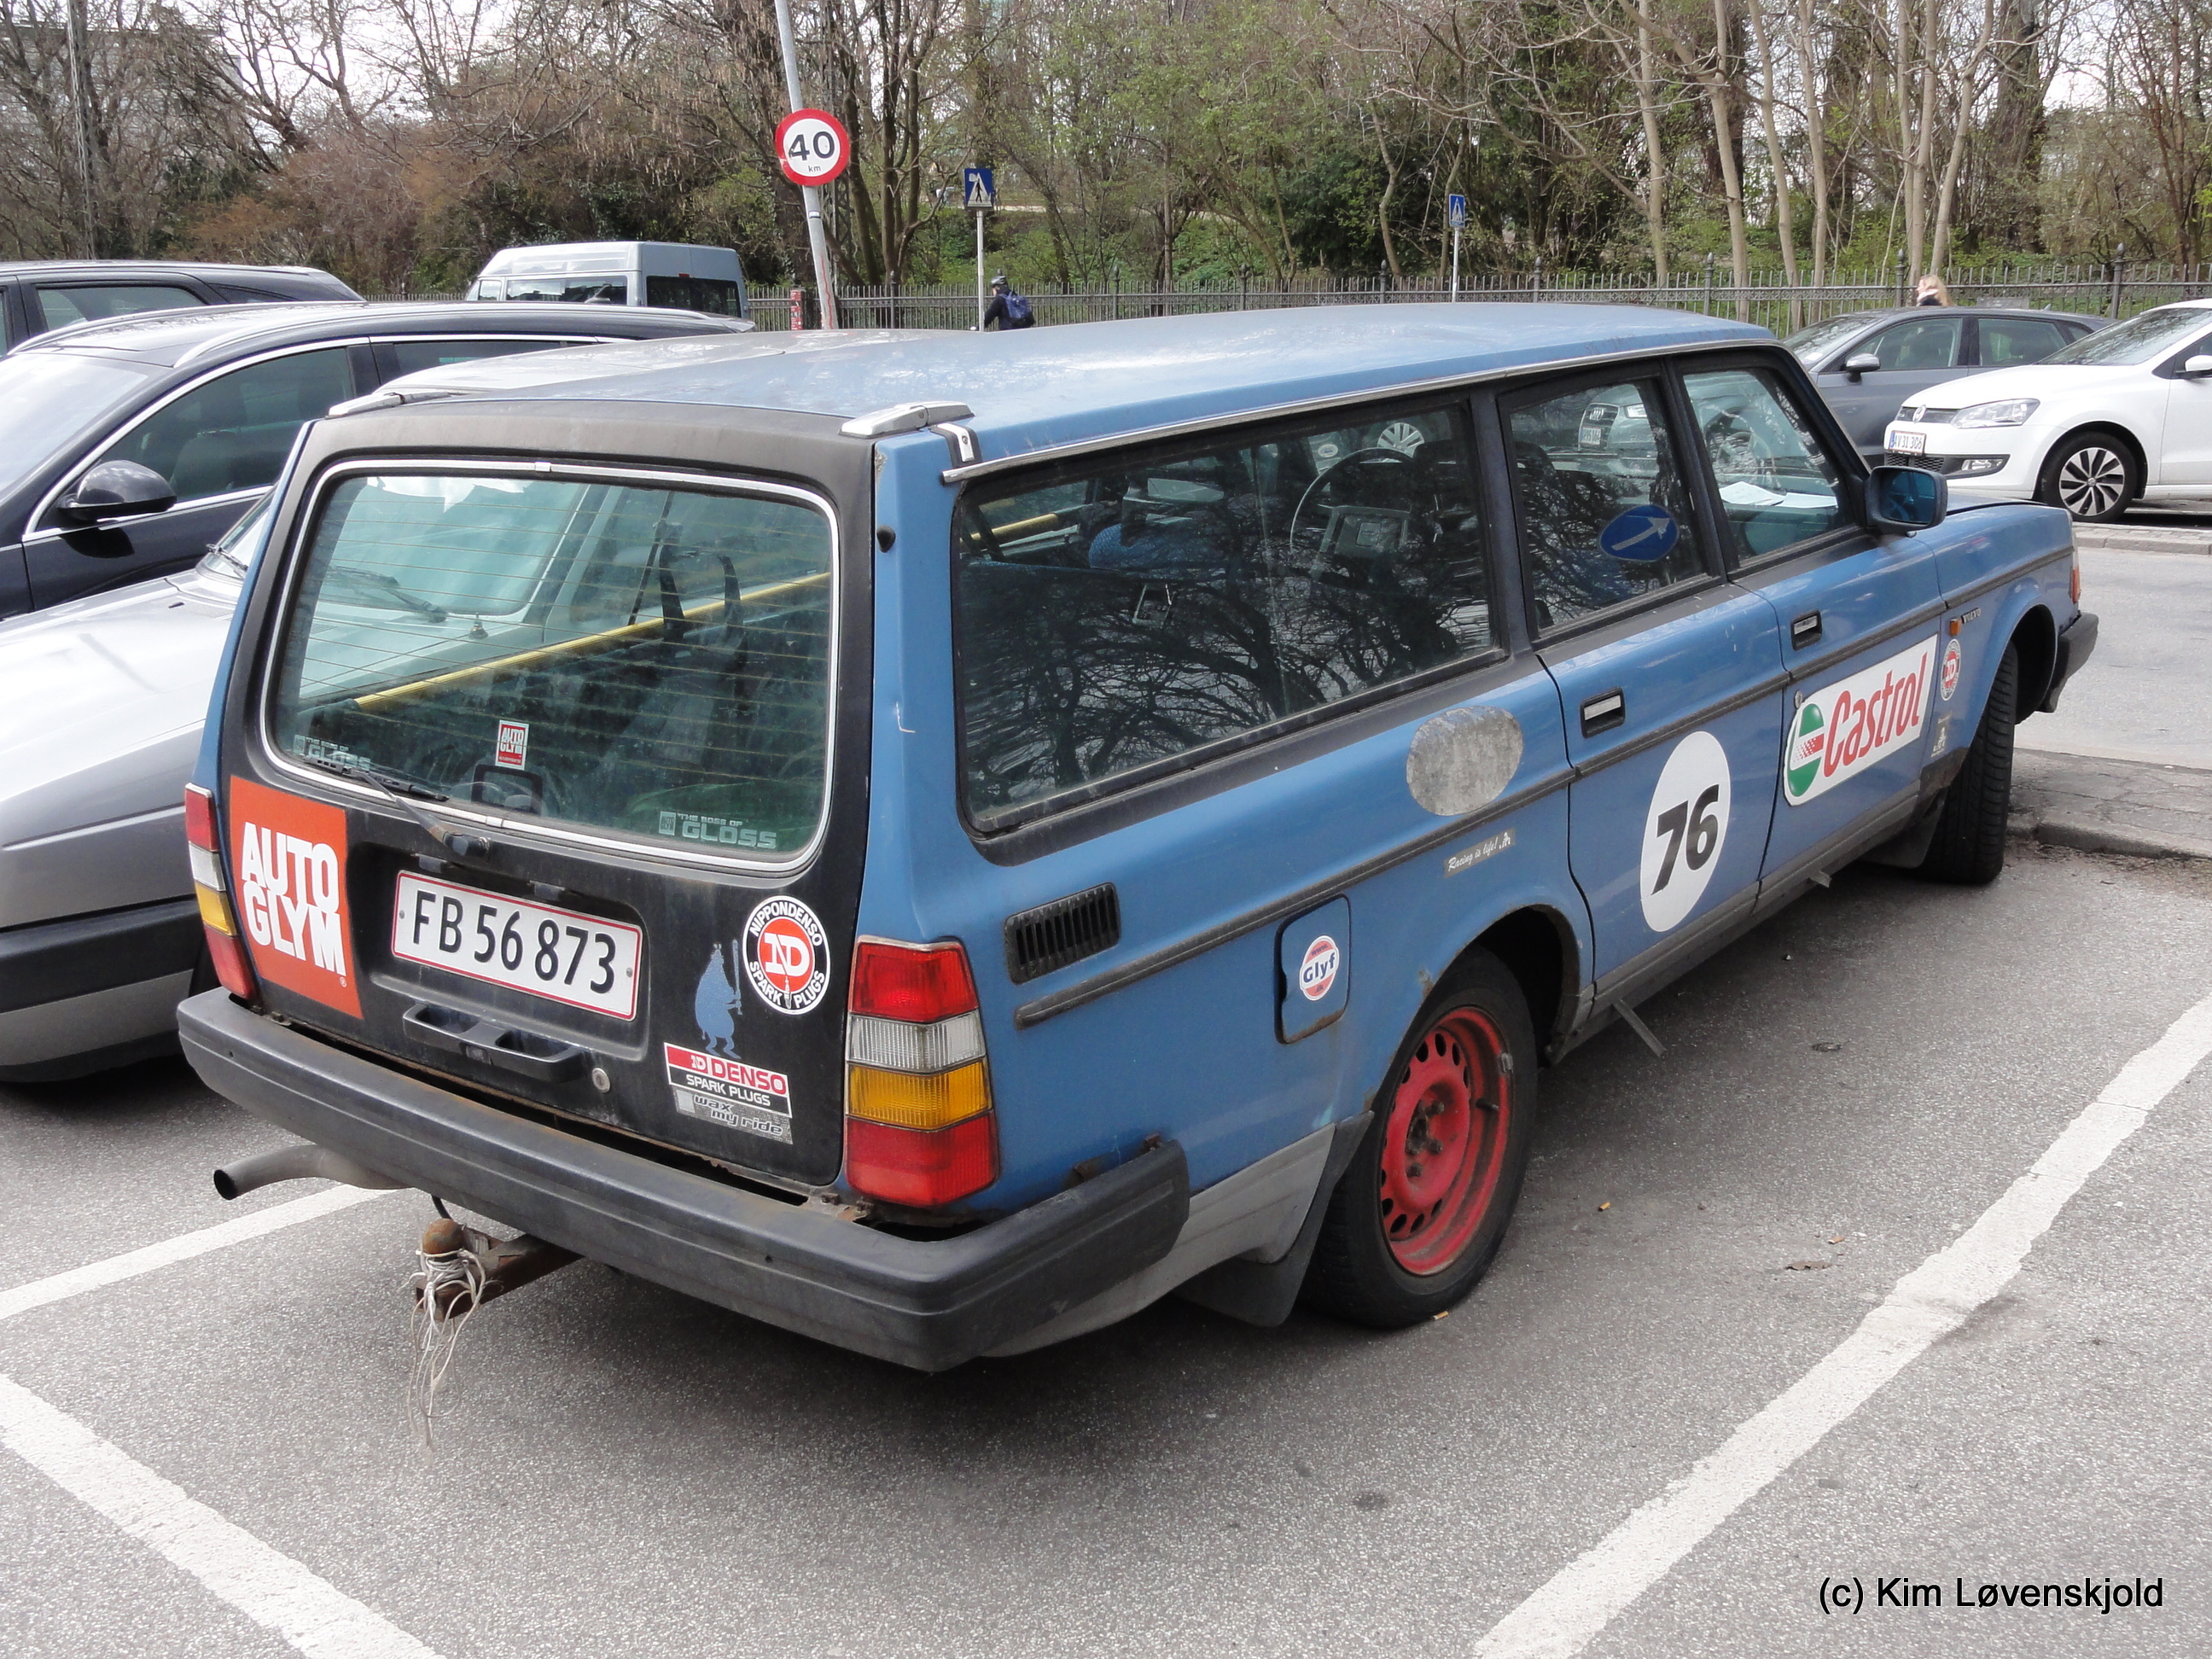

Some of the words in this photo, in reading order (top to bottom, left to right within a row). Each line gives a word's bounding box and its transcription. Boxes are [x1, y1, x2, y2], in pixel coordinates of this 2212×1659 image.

[789, 131, 835, 160] 40
[1962, 608, 1982, 624] VOLVO
[1823, 652, 1928, 777] Castrol
[502, 727, 525, 744] AUTO
[677, 812, 698, 822] THE
[701, 816, 726, 825] BOSS
[682, 821, 777, 849] GLOSS
[1651, 784, 1720, 895] 76
[242, 822, 339, 915] AUTO
[1448, 856, 1473, 871] Racing
[1475, 848, 1481, 859] is
[243, 881, 346, 976] GLYM
[749, 901, 823, 946] NIPPONDENSO
[413, 889, 463, 953] FB
[474, 905, 523, 971] 56
[535, 919, 615, 994] 873
[1303, 952, 1335, 983] Glyf
[750, 961, 783, 1005] SPARK
[794, 970, 825, 1008] PLUGS
[686, 1074, 726, 1095] SPARK
[729, 1086, 771, 1106] PLUGS
[711, 1057, 786, 1095] DENSO
[694, 1094, 735, 1114] wax
[711, 1109, 739, 1127] my
[741, 1116, 783, 1137] ride
